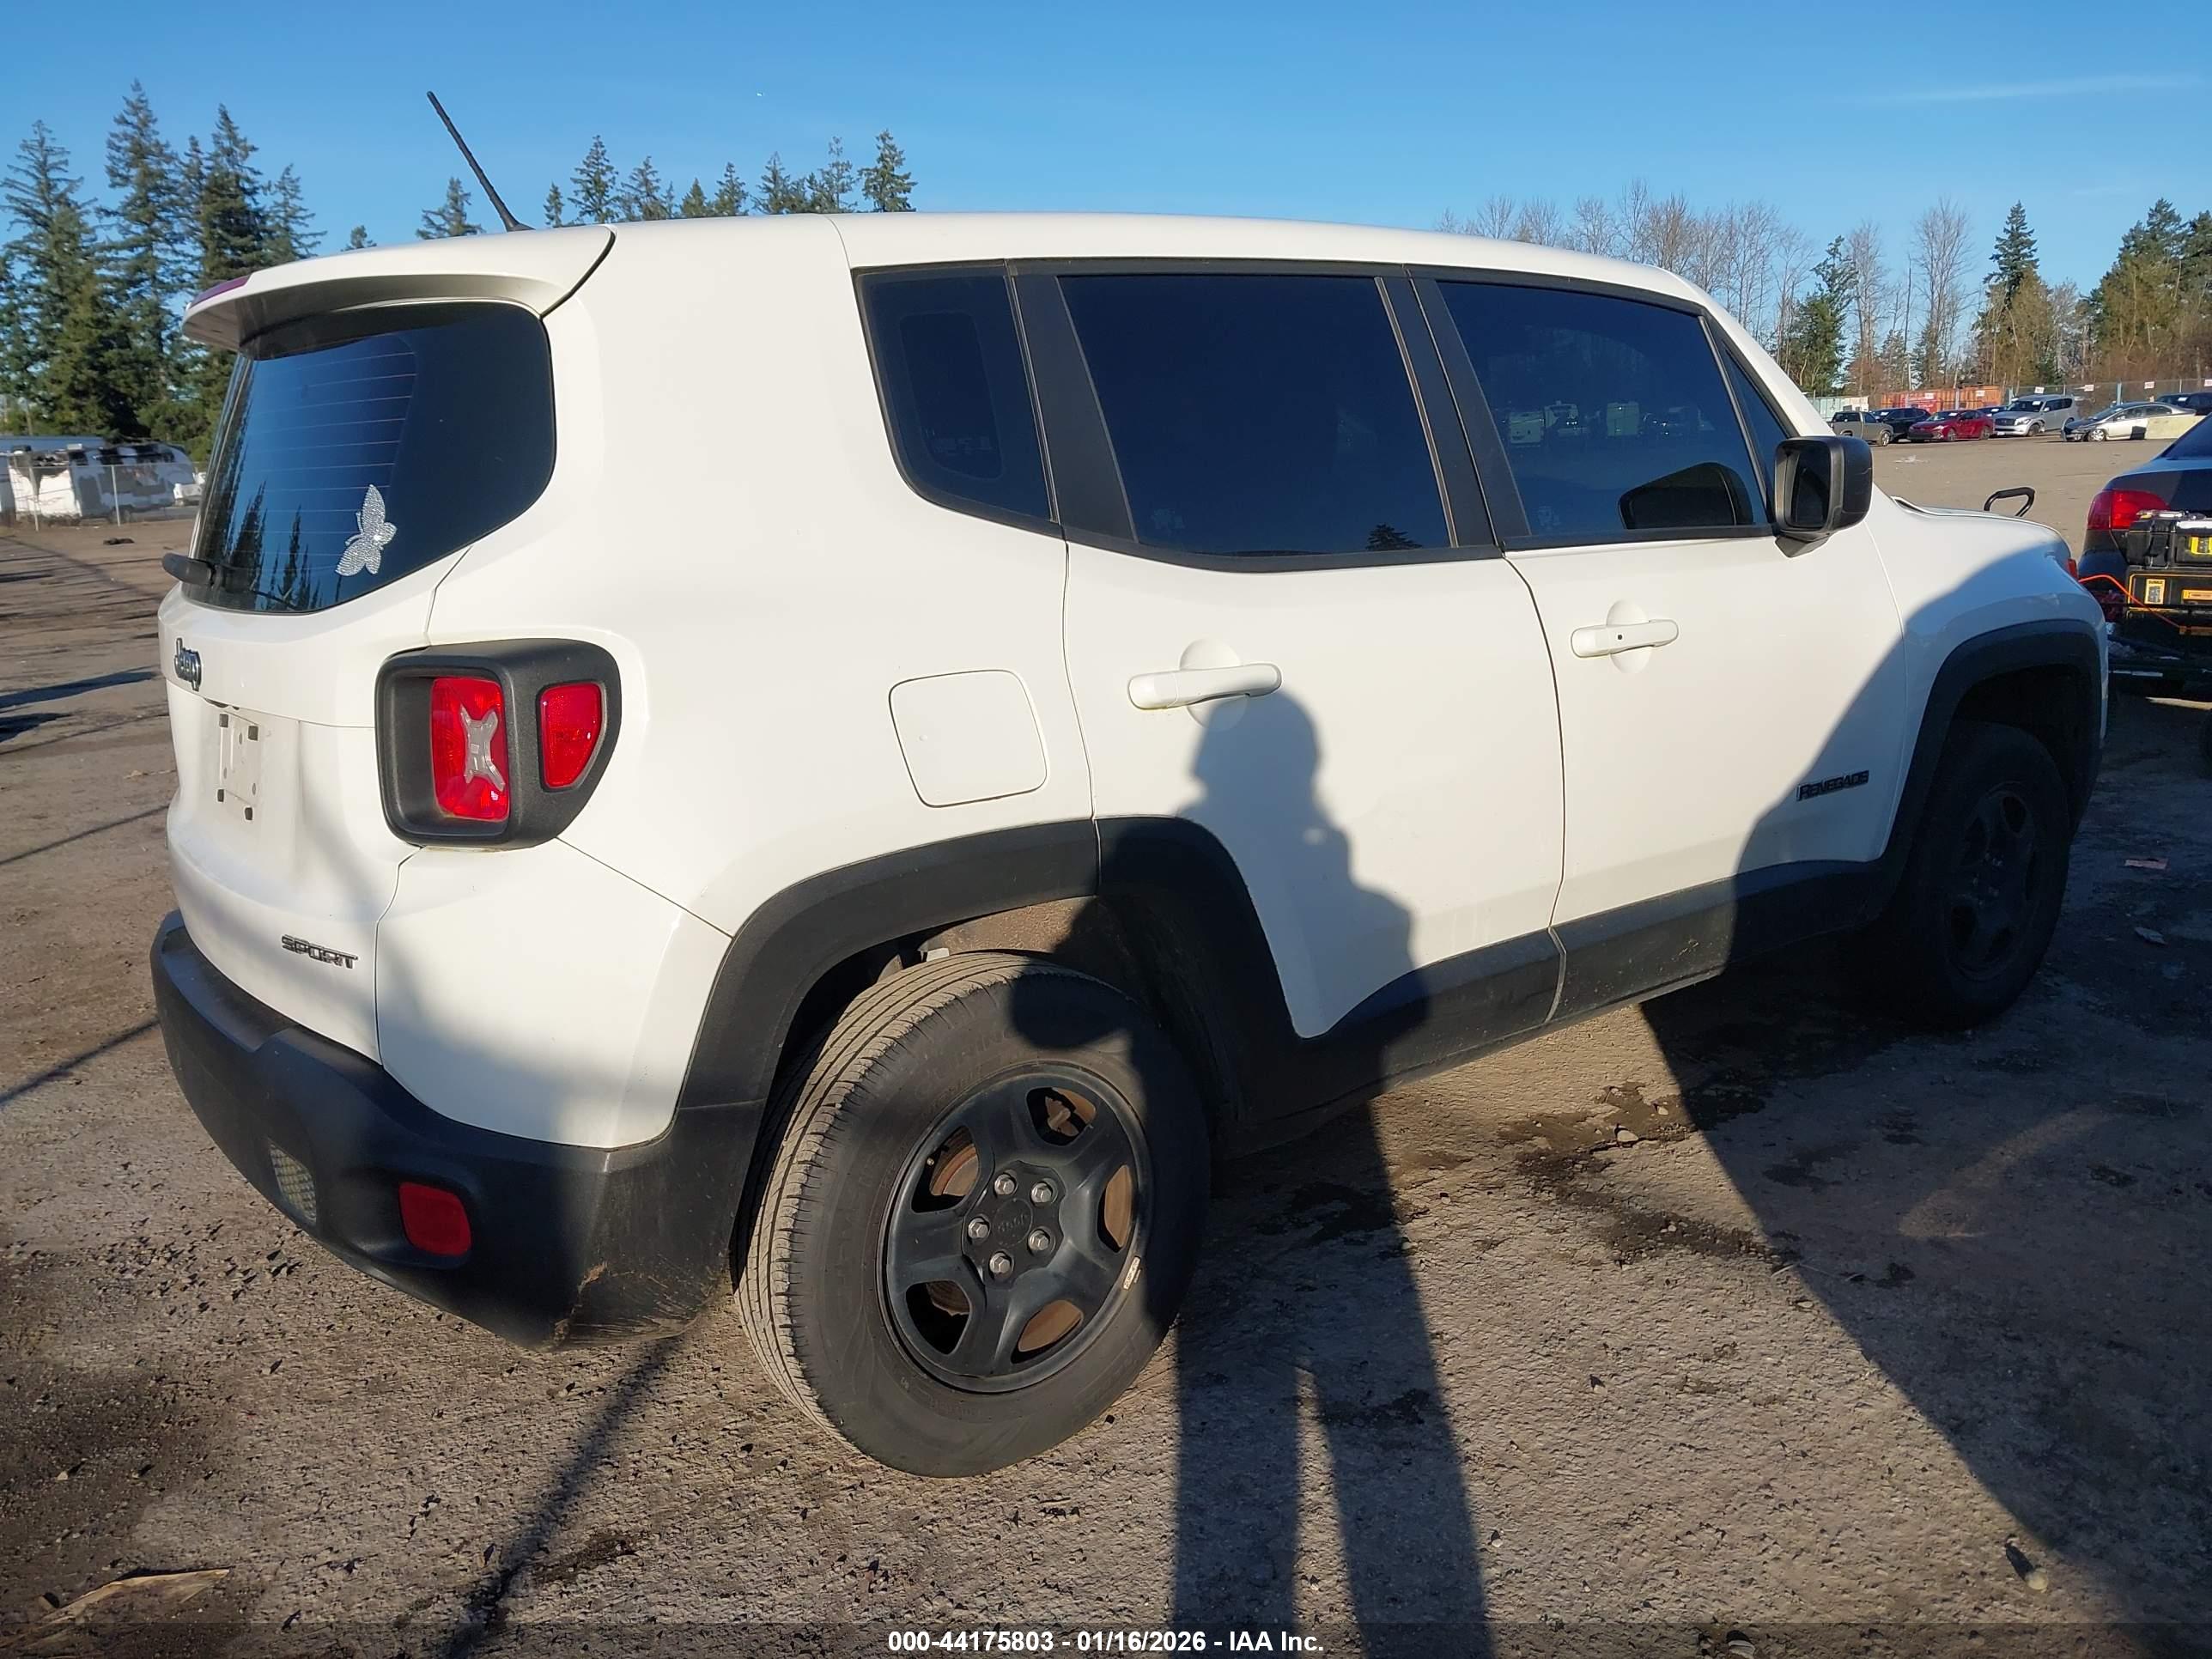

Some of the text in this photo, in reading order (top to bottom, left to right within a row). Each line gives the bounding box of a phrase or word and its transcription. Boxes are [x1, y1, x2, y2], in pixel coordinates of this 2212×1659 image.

[174, 637, 202, 692] Jeep
[1796, 769, 1869, 802] RENEGADE
[281, 933, 359, 969] SPORT
